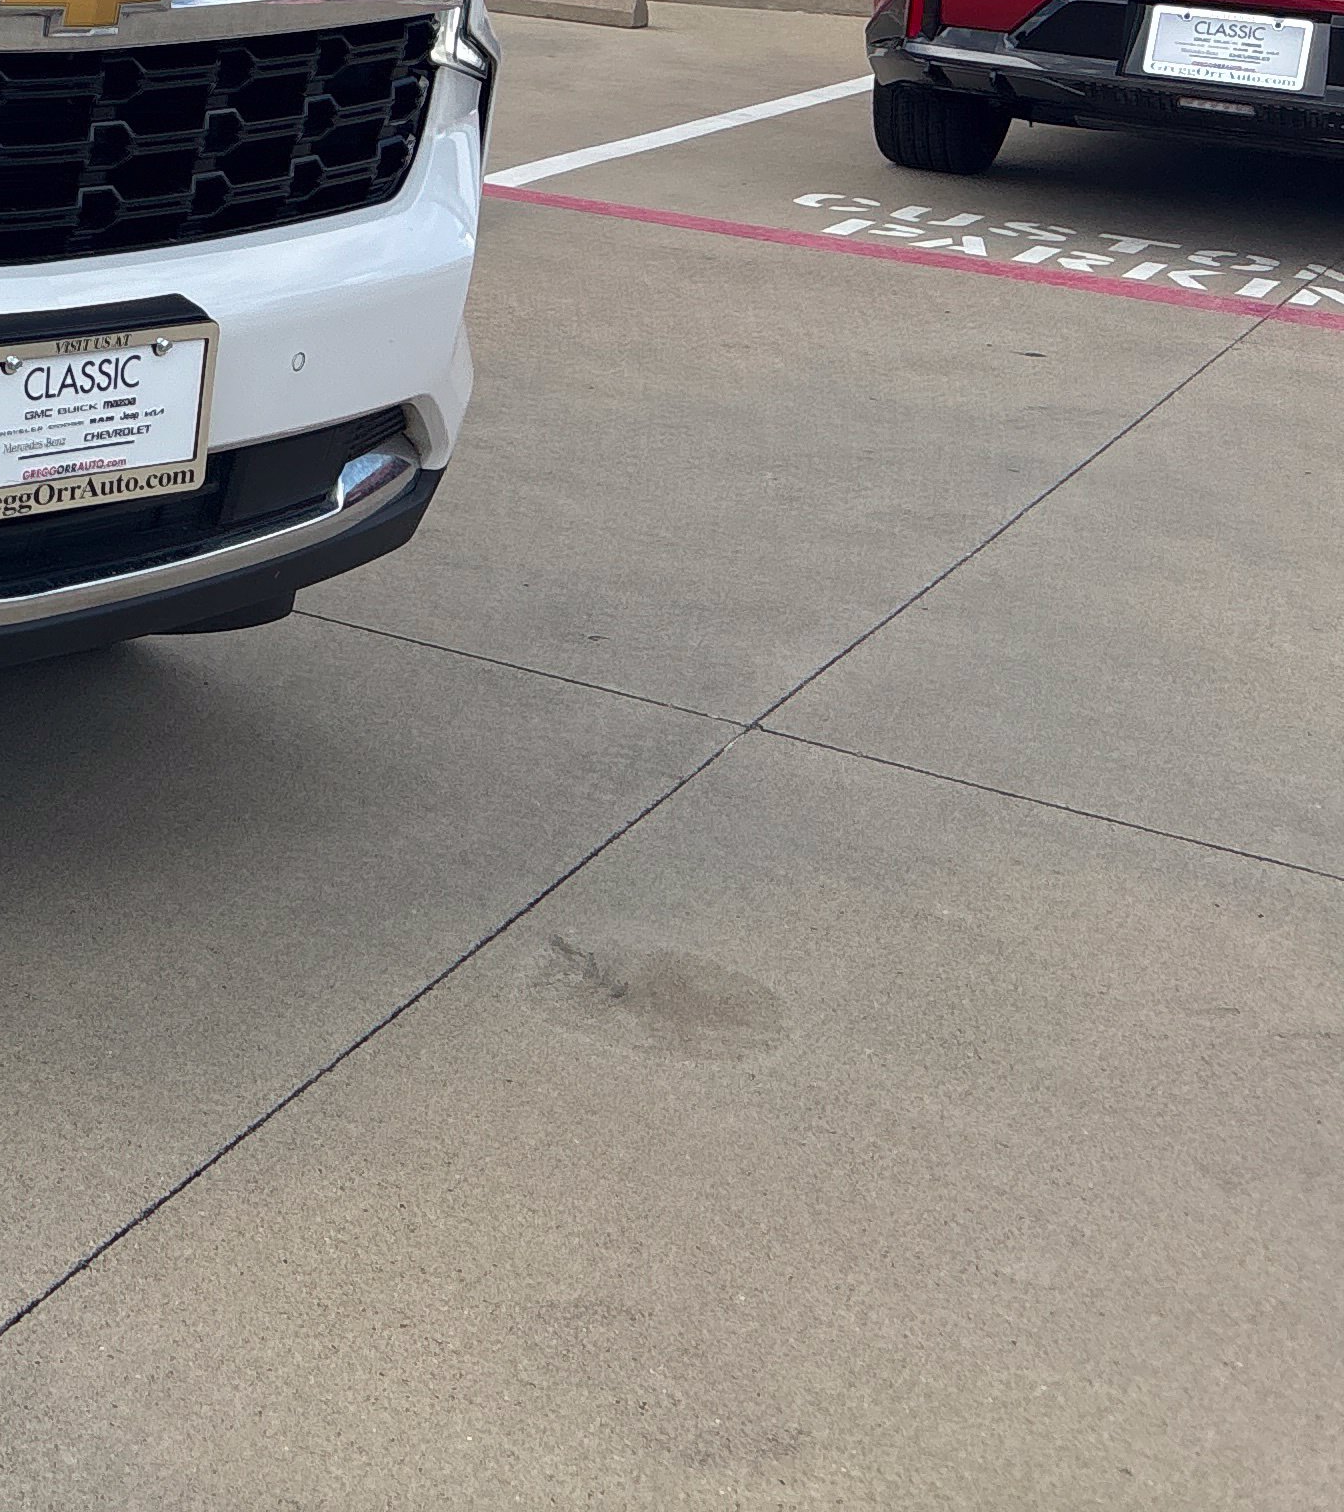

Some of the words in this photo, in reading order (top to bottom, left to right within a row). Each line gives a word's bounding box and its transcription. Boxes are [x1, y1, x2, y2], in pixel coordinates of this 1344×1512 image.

[1194, 20, 1267, 41] CLASSIC
[56, 338, 91, 354] VISIT
[94, 335, 112, 349] US
[23, 354, 142, 401] CLASSIC
[24, 408, 53, 420] GMC
[57, 403, 98, 415] BUICK
[83, 423, 152, 442] CHEVROLET
